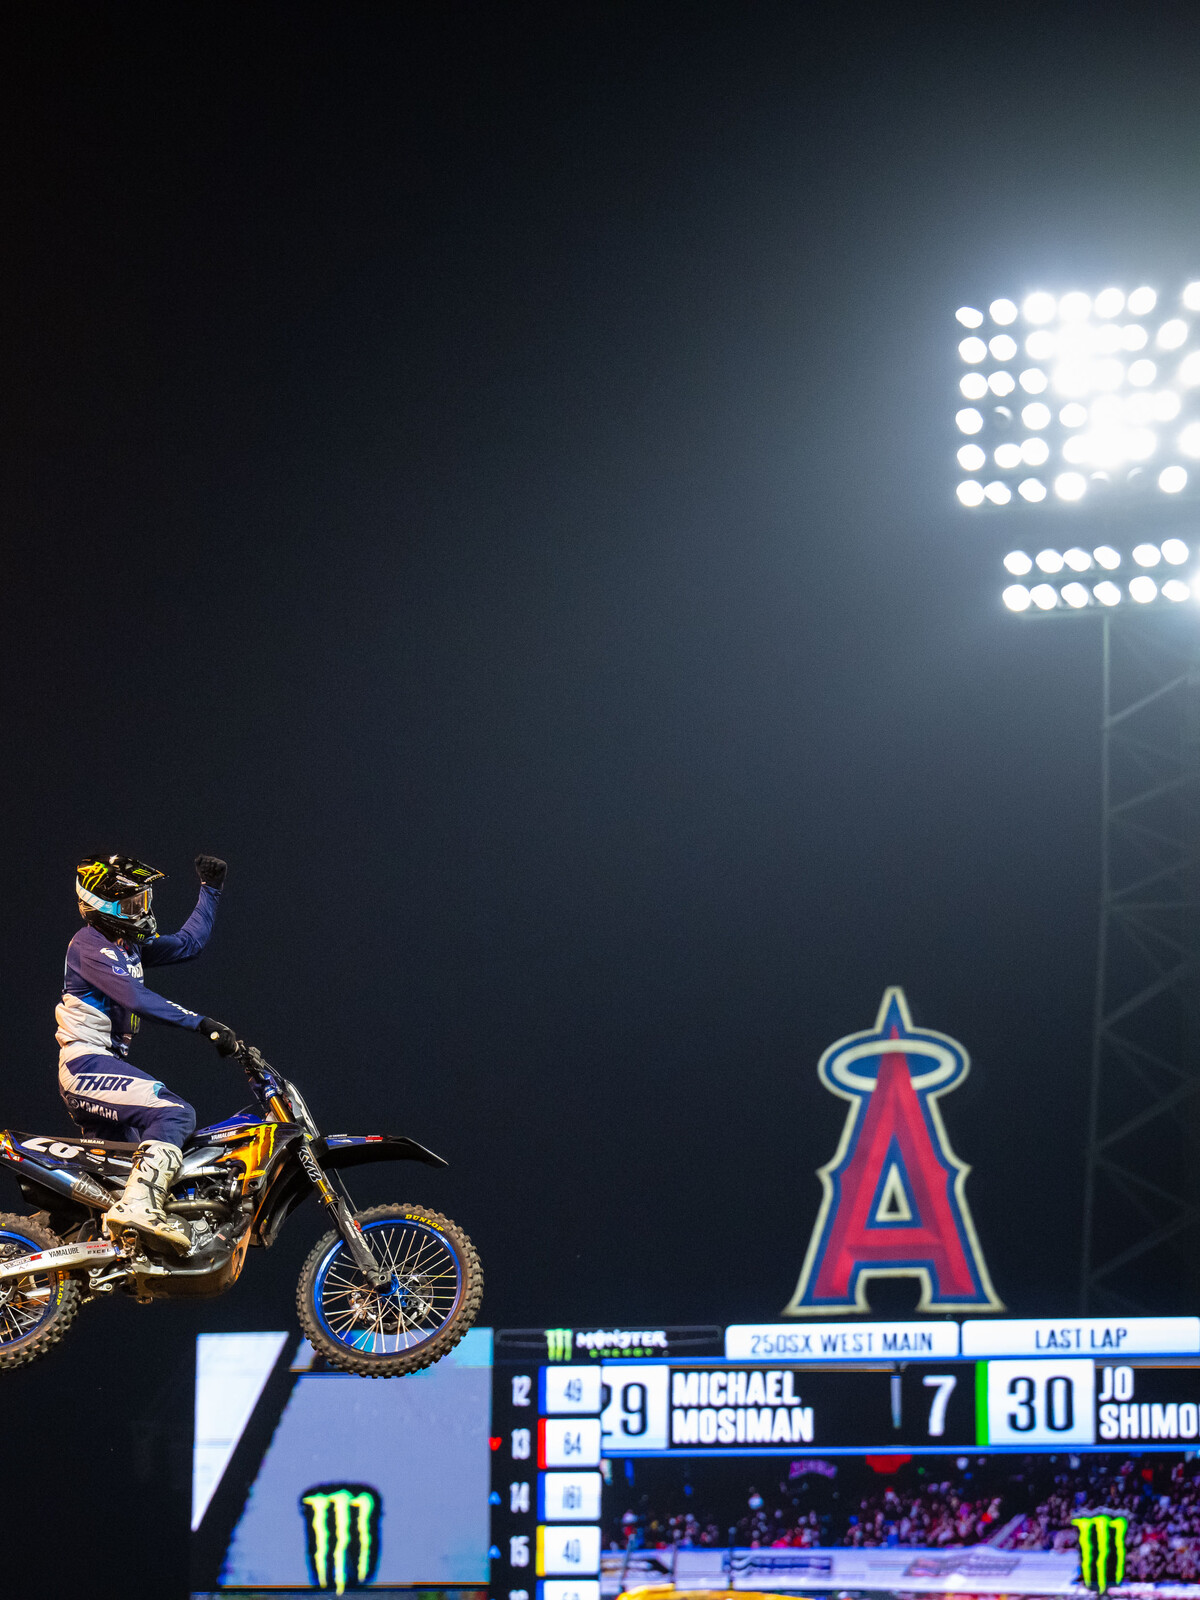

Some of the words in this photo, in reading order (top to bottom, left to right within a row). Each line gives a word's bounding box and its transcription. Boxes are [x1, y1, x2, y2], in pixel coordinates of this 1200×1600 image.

[75, 1075, 134, 1091] THOR
[79, 1100, 119, 1121] YAMAHA
[298, 1146, 322, 1182] KYB
[404, 1213, 445, 1232] DUNLOP
[48, 1246, 80, 1259] YAMALUBE
[820, 1333, 873, 1353] WEST
[882, 1332, 933, 1352] MAIN
[1034, 1328, 1083, 1350] LAST
[1090, 1328, 1128, 1349] LAP
[672, 1371, 802, 1407] MICHAEL
[1098, 1366, 1135, 1402] JO
[922, 1375, 957, 1436] 7
[1007, 1375, 1075, 1432] 30
[1099, 1402, 1200, 1440] SHIMO
[671, 1407, 815, 1444] MOSIMAN
